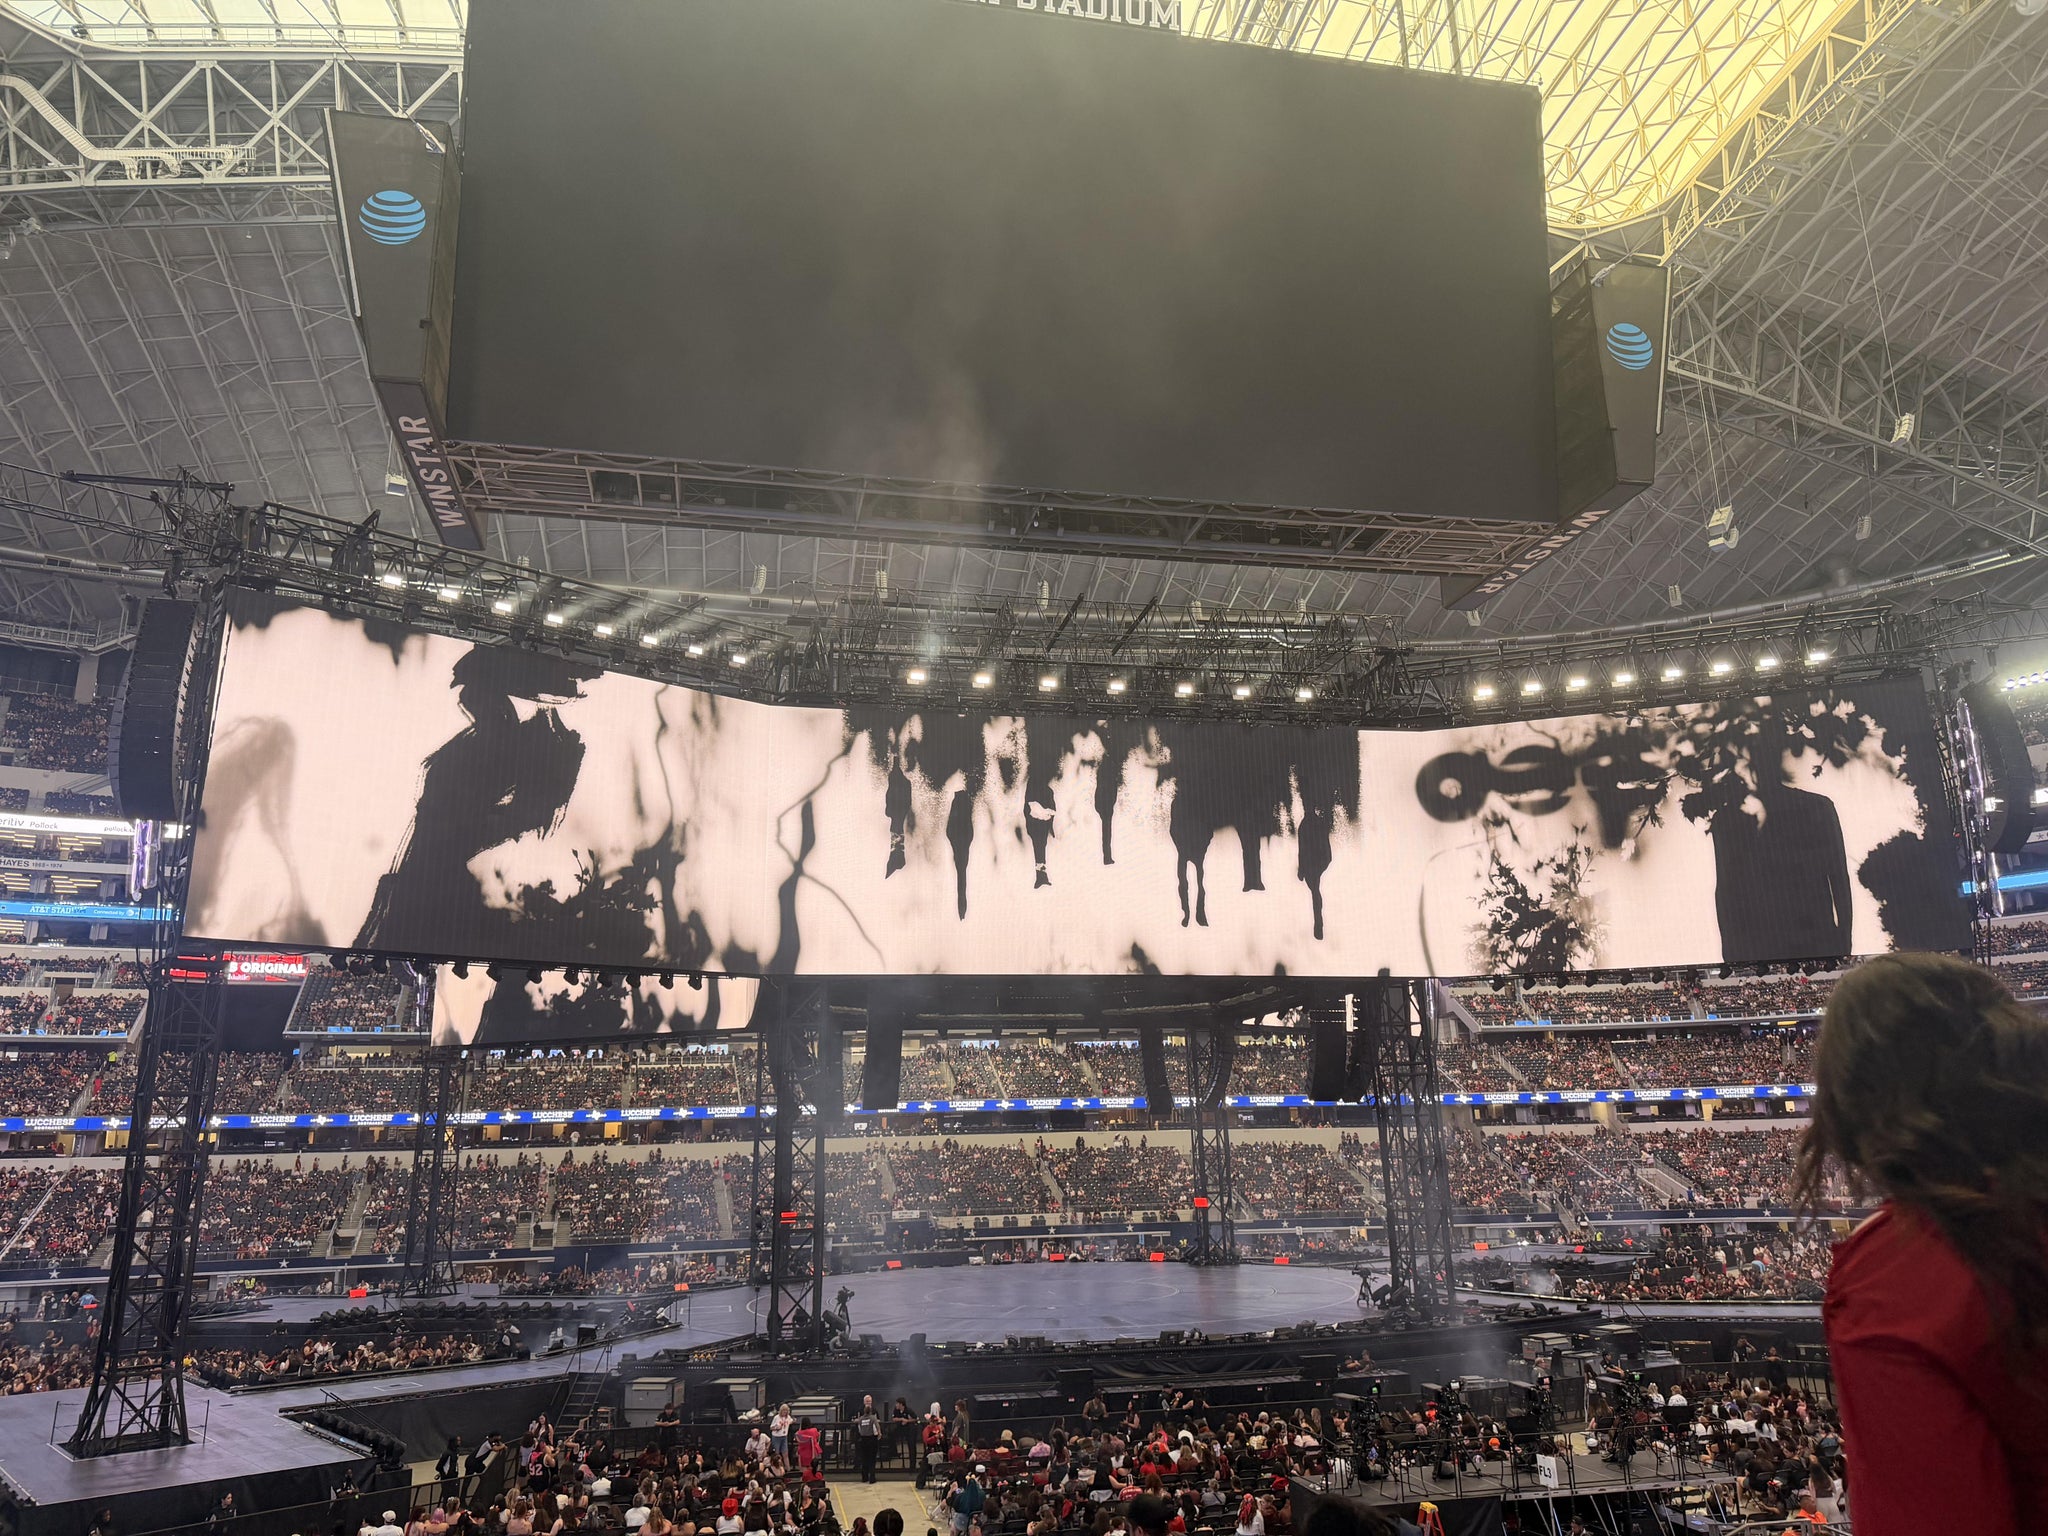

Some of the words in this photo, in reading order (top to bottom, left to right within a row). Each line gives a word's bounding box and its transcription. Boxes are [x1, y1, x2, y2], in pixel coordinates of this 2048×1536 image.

[398, 415, 466, 528] WINSTAR
[1475, 509, 1610, 594] WINSTAR
[29, 821, 59, 829] Pollock
[29, 905, 50, 913] AT&T
[240, 962, 306, 974] ORIGINAL
[24, 1118, 77, 1126] LUCCHESE
[250, 1115, 297, 1123] LUCCHESE
[529, 1463, 543, 1476] 92
[1539, 1465, 1552, 1479] FL3
